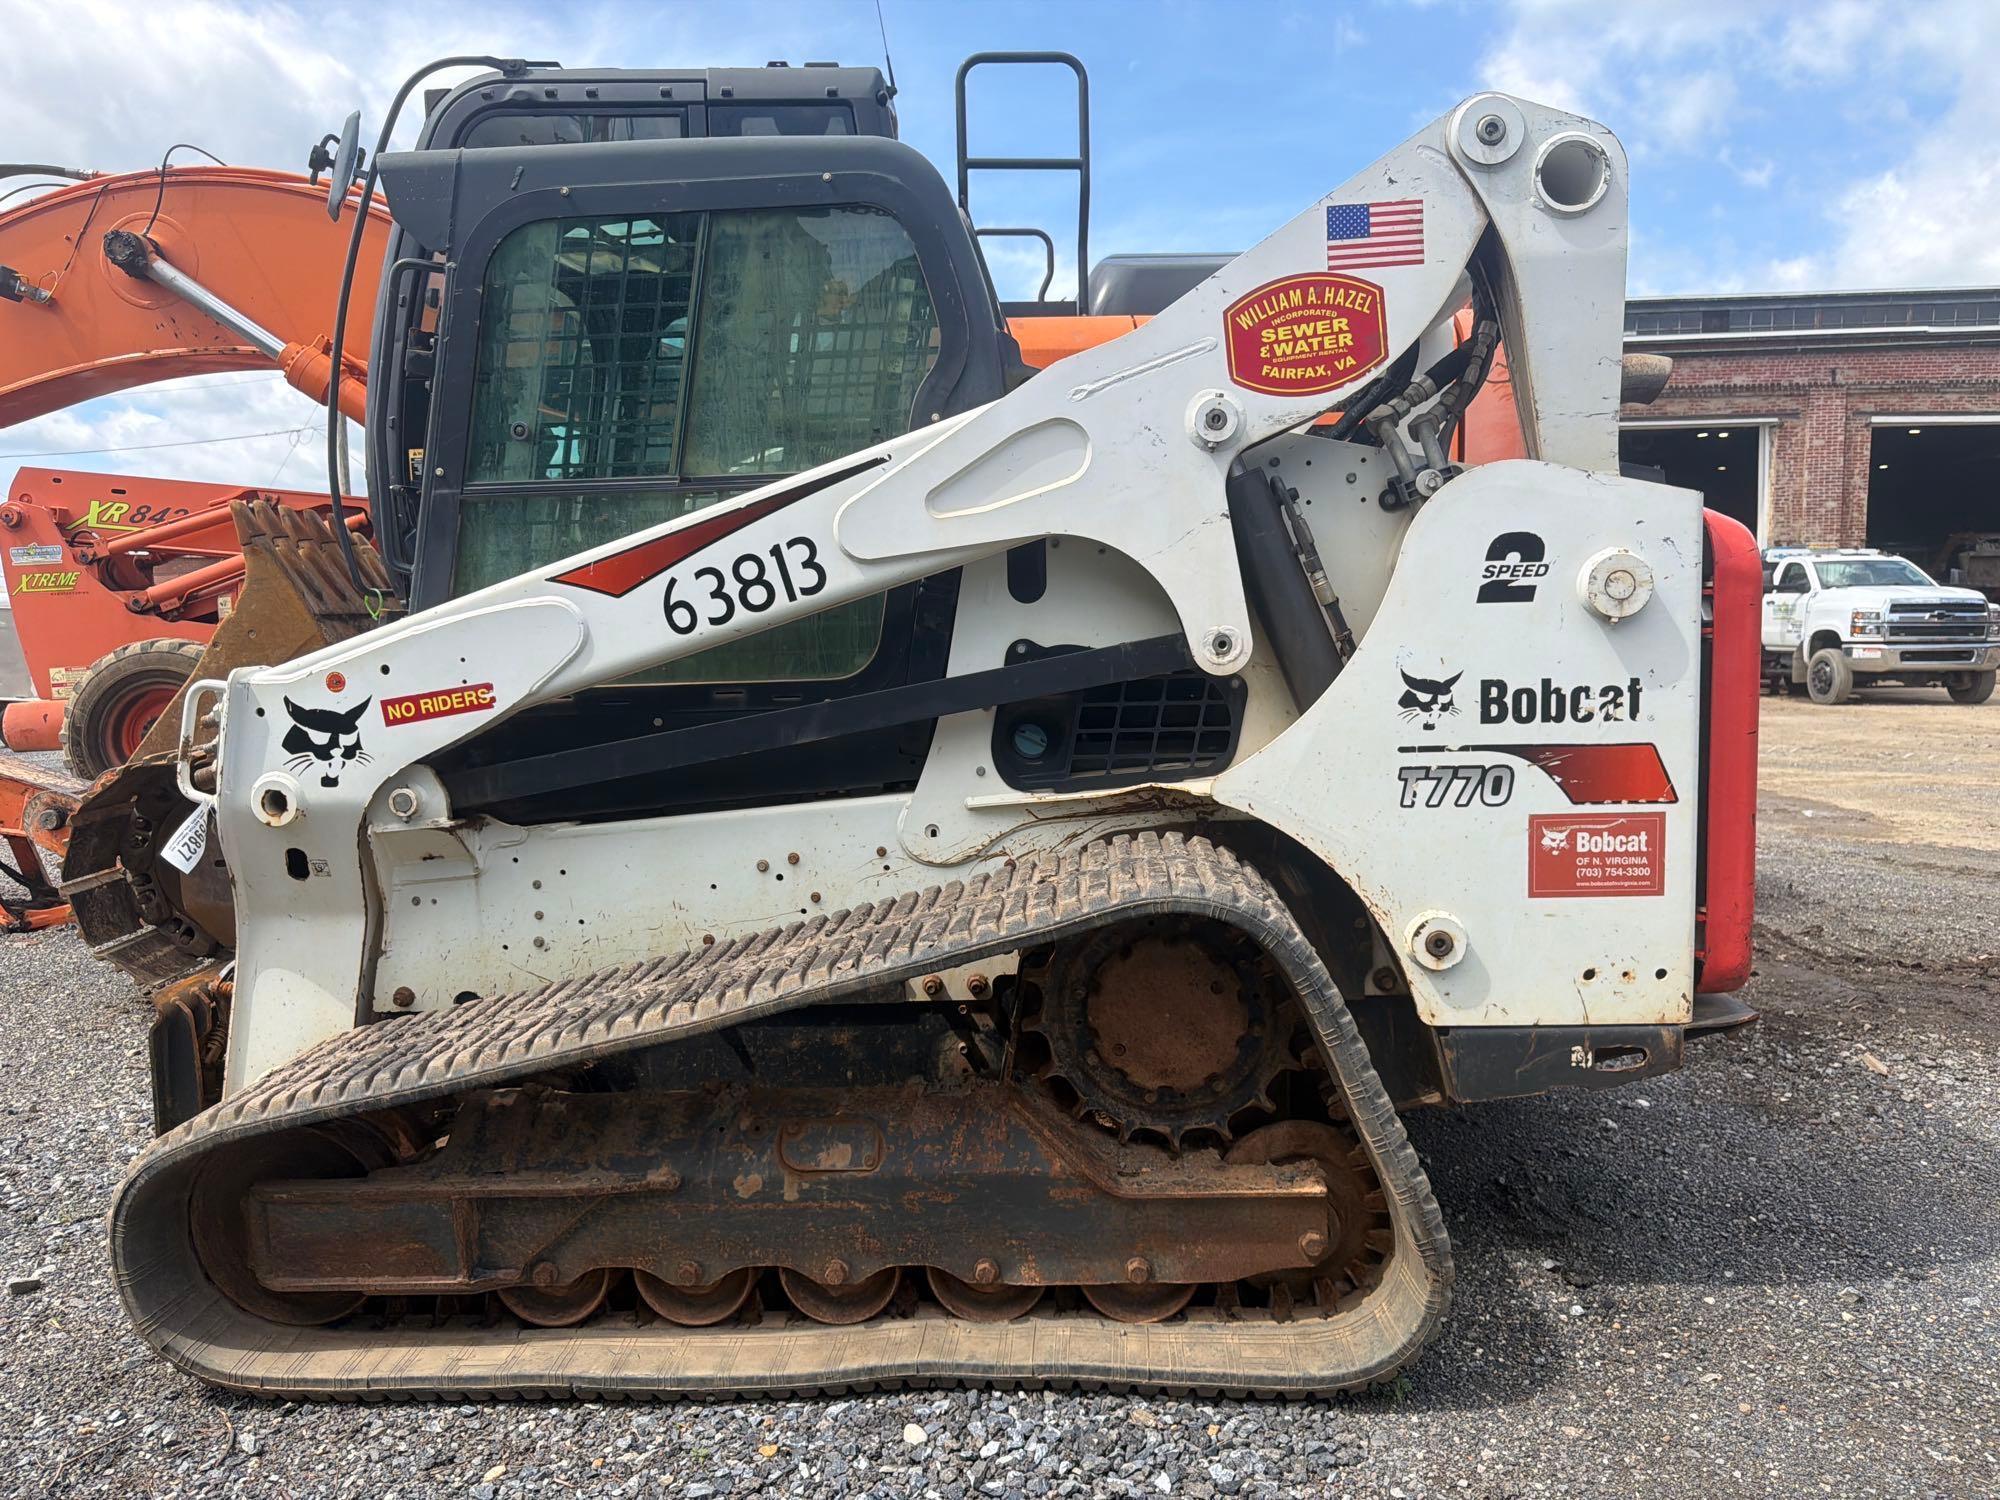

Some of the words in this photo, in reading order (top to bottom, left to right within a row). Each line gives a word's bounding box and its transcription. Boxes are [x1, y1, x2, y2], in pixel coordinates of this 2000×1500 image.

[1235, 288, 1302, 331] WILLIAM
[1307, 286, 1321, 305] A.
[1324, 286, 1373, 314] HAZEL
[1271, 309, 1338, 326] INCORPORATED
[1260, 317, 1350, 343] SEWER
[1259, 344, 1271, 359] &
[1273, 332, 1354, 357] WATER
[1272, 352, 1318, 364] EQUIPMENT
[1318, 347, 1349, 356] RENTAL
[1261, 364, 1332, 380] FAIRFAX,
[1334, 355, 1357, 371] VA
[65, 499, 131, 530] XR
[1475, 531, 1546, 604] 2
[1481, 563, 1550, 580] SPEED
[12, 571, 81, 597] XTREME
[663, 536, 827, 635] 63813
[387, 702, 416, 721] NO
[419, 688, 491, 715] RIDERS
[1479, 677, 1643, 725] Bobcat
[1397, 764, 1516, 808] T770
[1576, 831, 1648, 853] Bobcat
[1576, 857, 1590, 865] OF
[1592, 857, 1603, 865] N.
[1605, 856, 1648, 865] VIRGINIA
[1576, 867, 1602, 878] (703)
[1605, 866, 1651, 877] 754-3300
